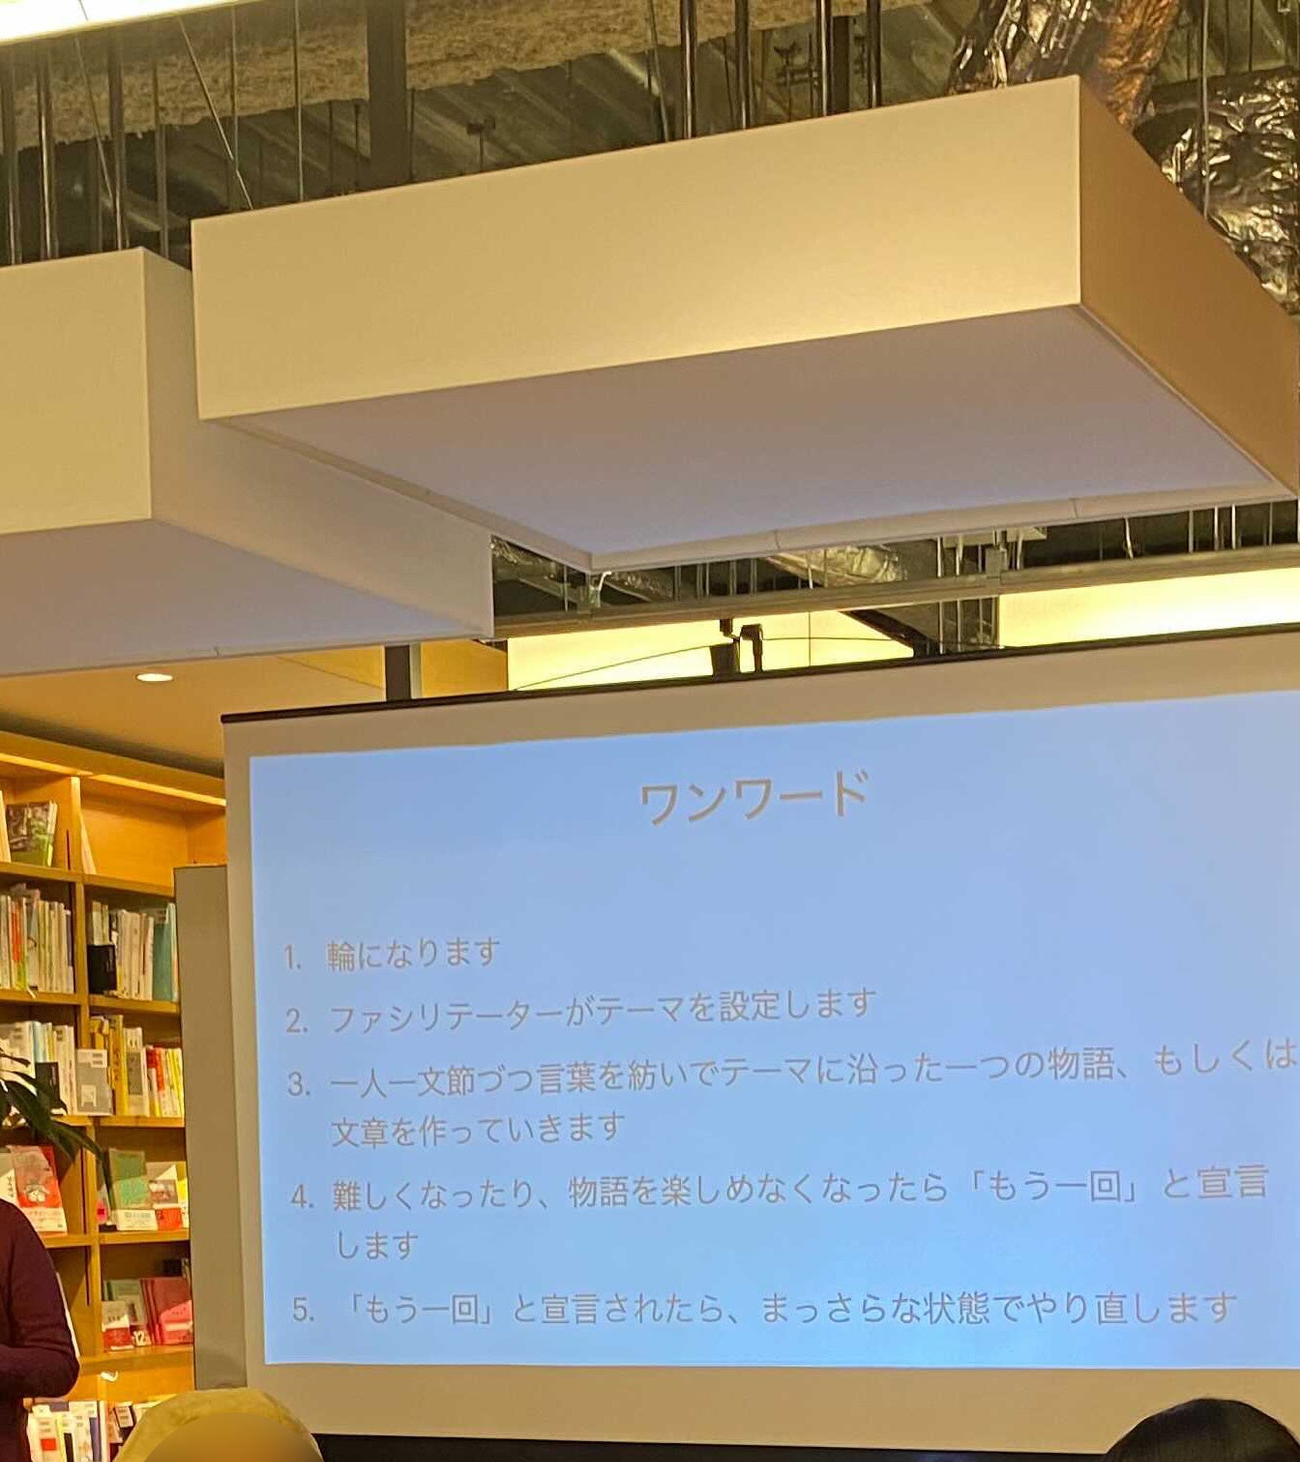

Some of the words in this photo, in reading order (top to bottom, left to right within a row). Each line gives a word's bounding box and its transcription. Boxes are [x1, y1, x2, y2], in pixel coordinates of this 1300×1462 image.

[640, 770, 869, 826] ワンワード
[283, 945, 302, 970] 1.
[327, 937, 500, 972] 輪になります
[286, 1008, 308, 1034] 2.
[331, 986, 877, 1035] ファシリテーターがテーマを設定します
[288, 1071, 311, 1098] 3.
[331, 1110, 626, 1150] 文章を作っていきます
[291, 1184, 314, 1209] 4.
[338, 1230, 419, 1260] します
[293, 1297, 315, 1322] 5.
